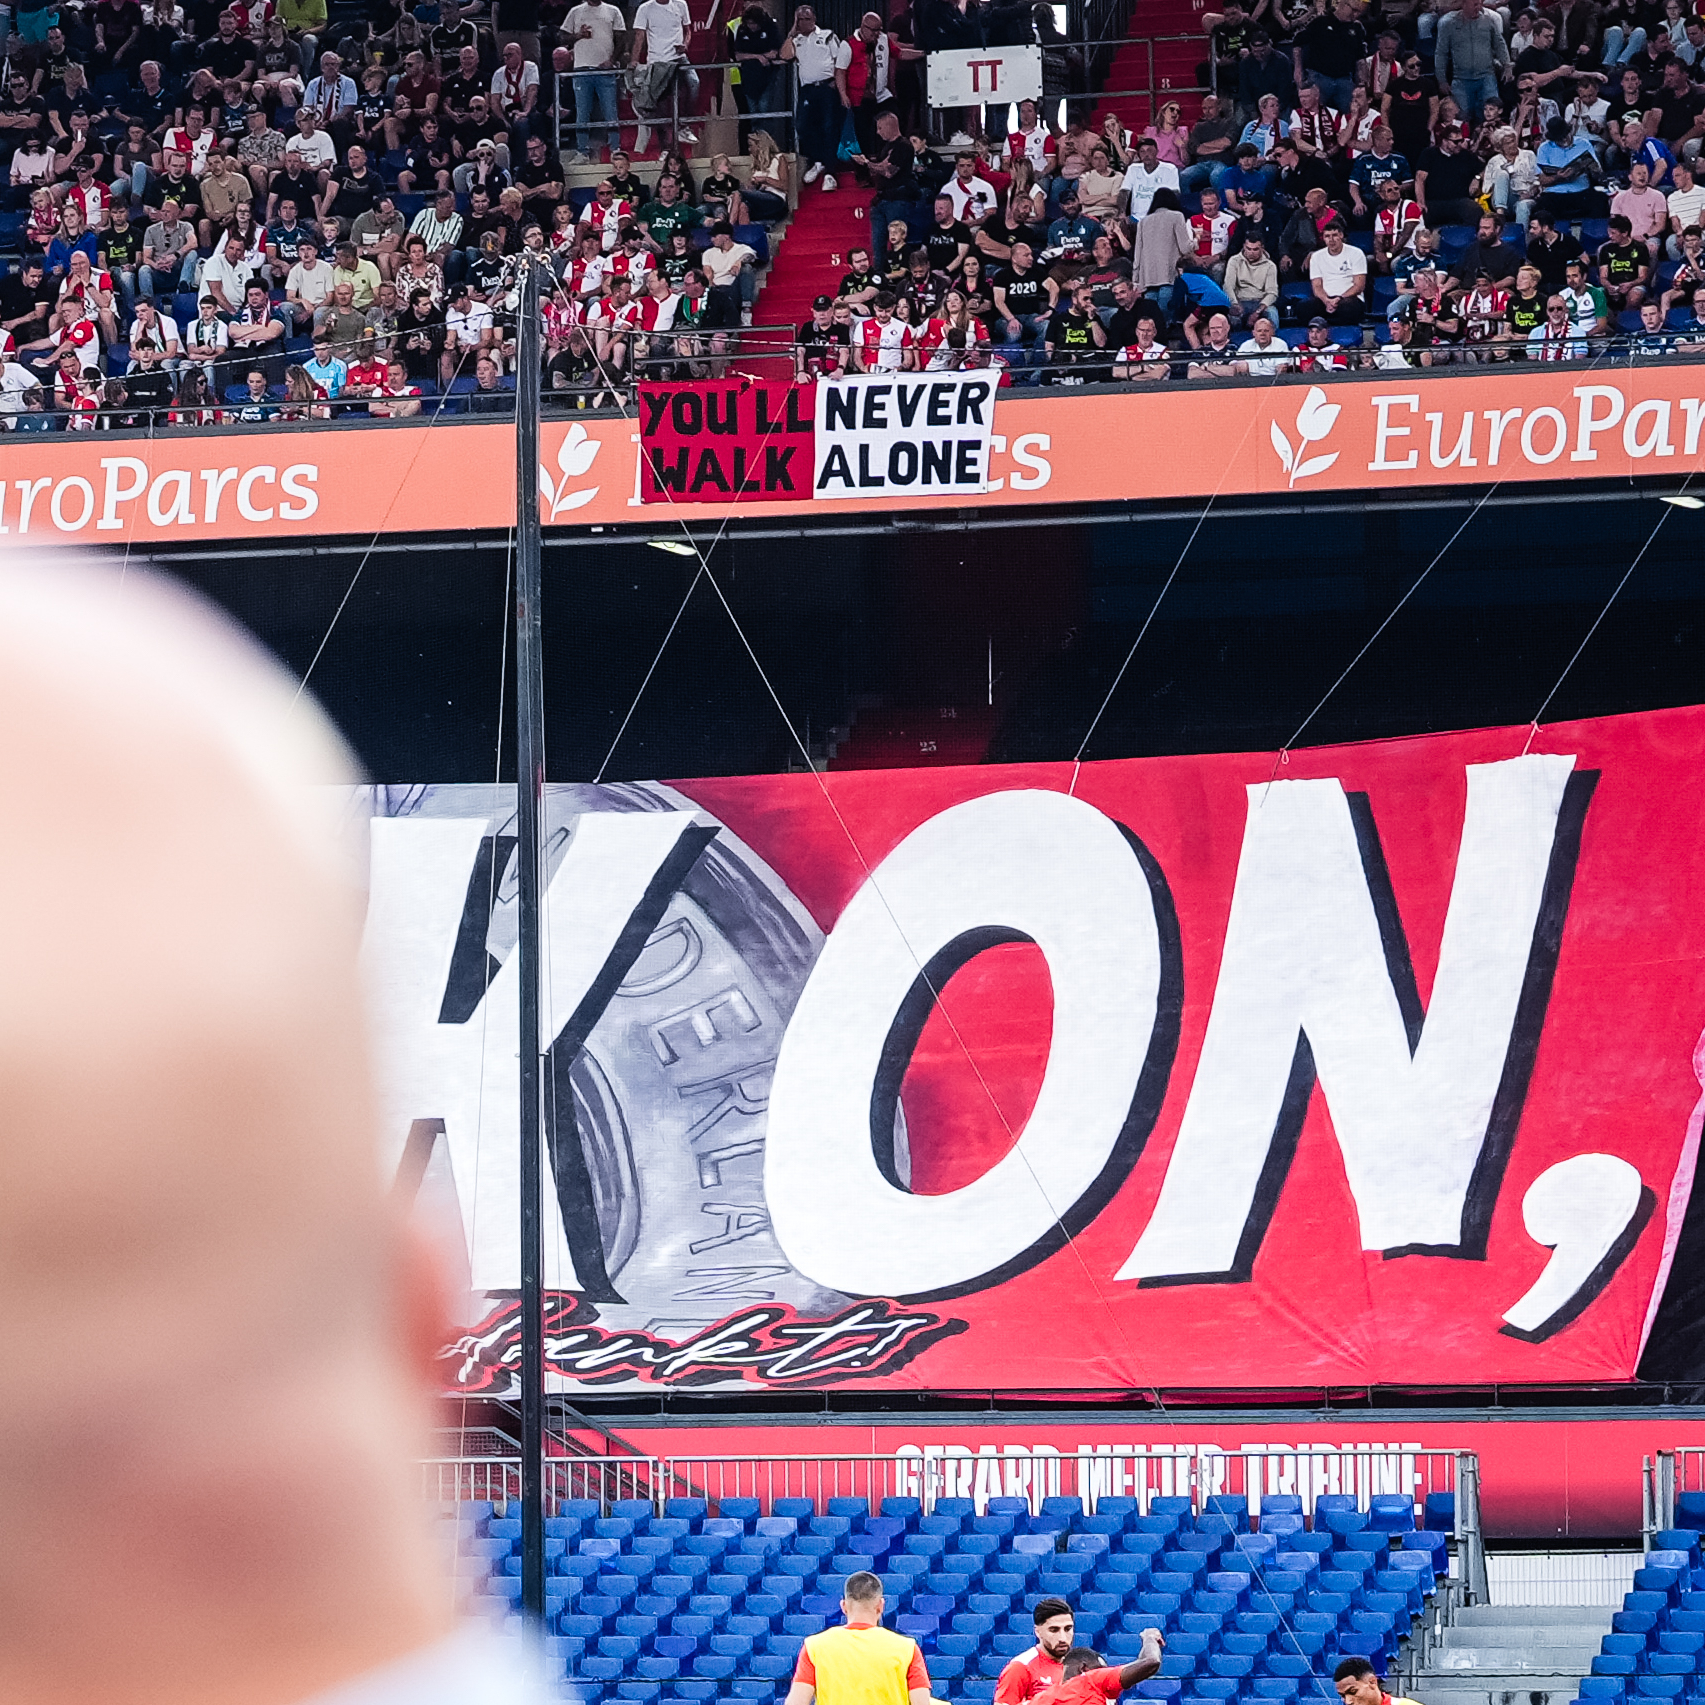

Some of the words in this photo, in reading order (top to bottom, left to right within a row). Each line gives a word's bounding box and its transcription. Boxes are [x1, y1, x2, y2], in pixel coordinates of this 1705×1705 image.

[967, 60, 1004, 93] TT
[854, 207, 863, 219] 6
[1009, 281, 1037, 295] 2020
[640, 381, 815, 436] YOU'LL
[826, 380, 990, 431] NEVER
[652, 446, 797, 494] WALK
[816, 440, 983, 490] ALONE
[761, 752, 1644, 1333] ON,
[895, 1443, 1064, 1517] GERARD
[1240, 1442, 1424, 1517] TRIBUNE
